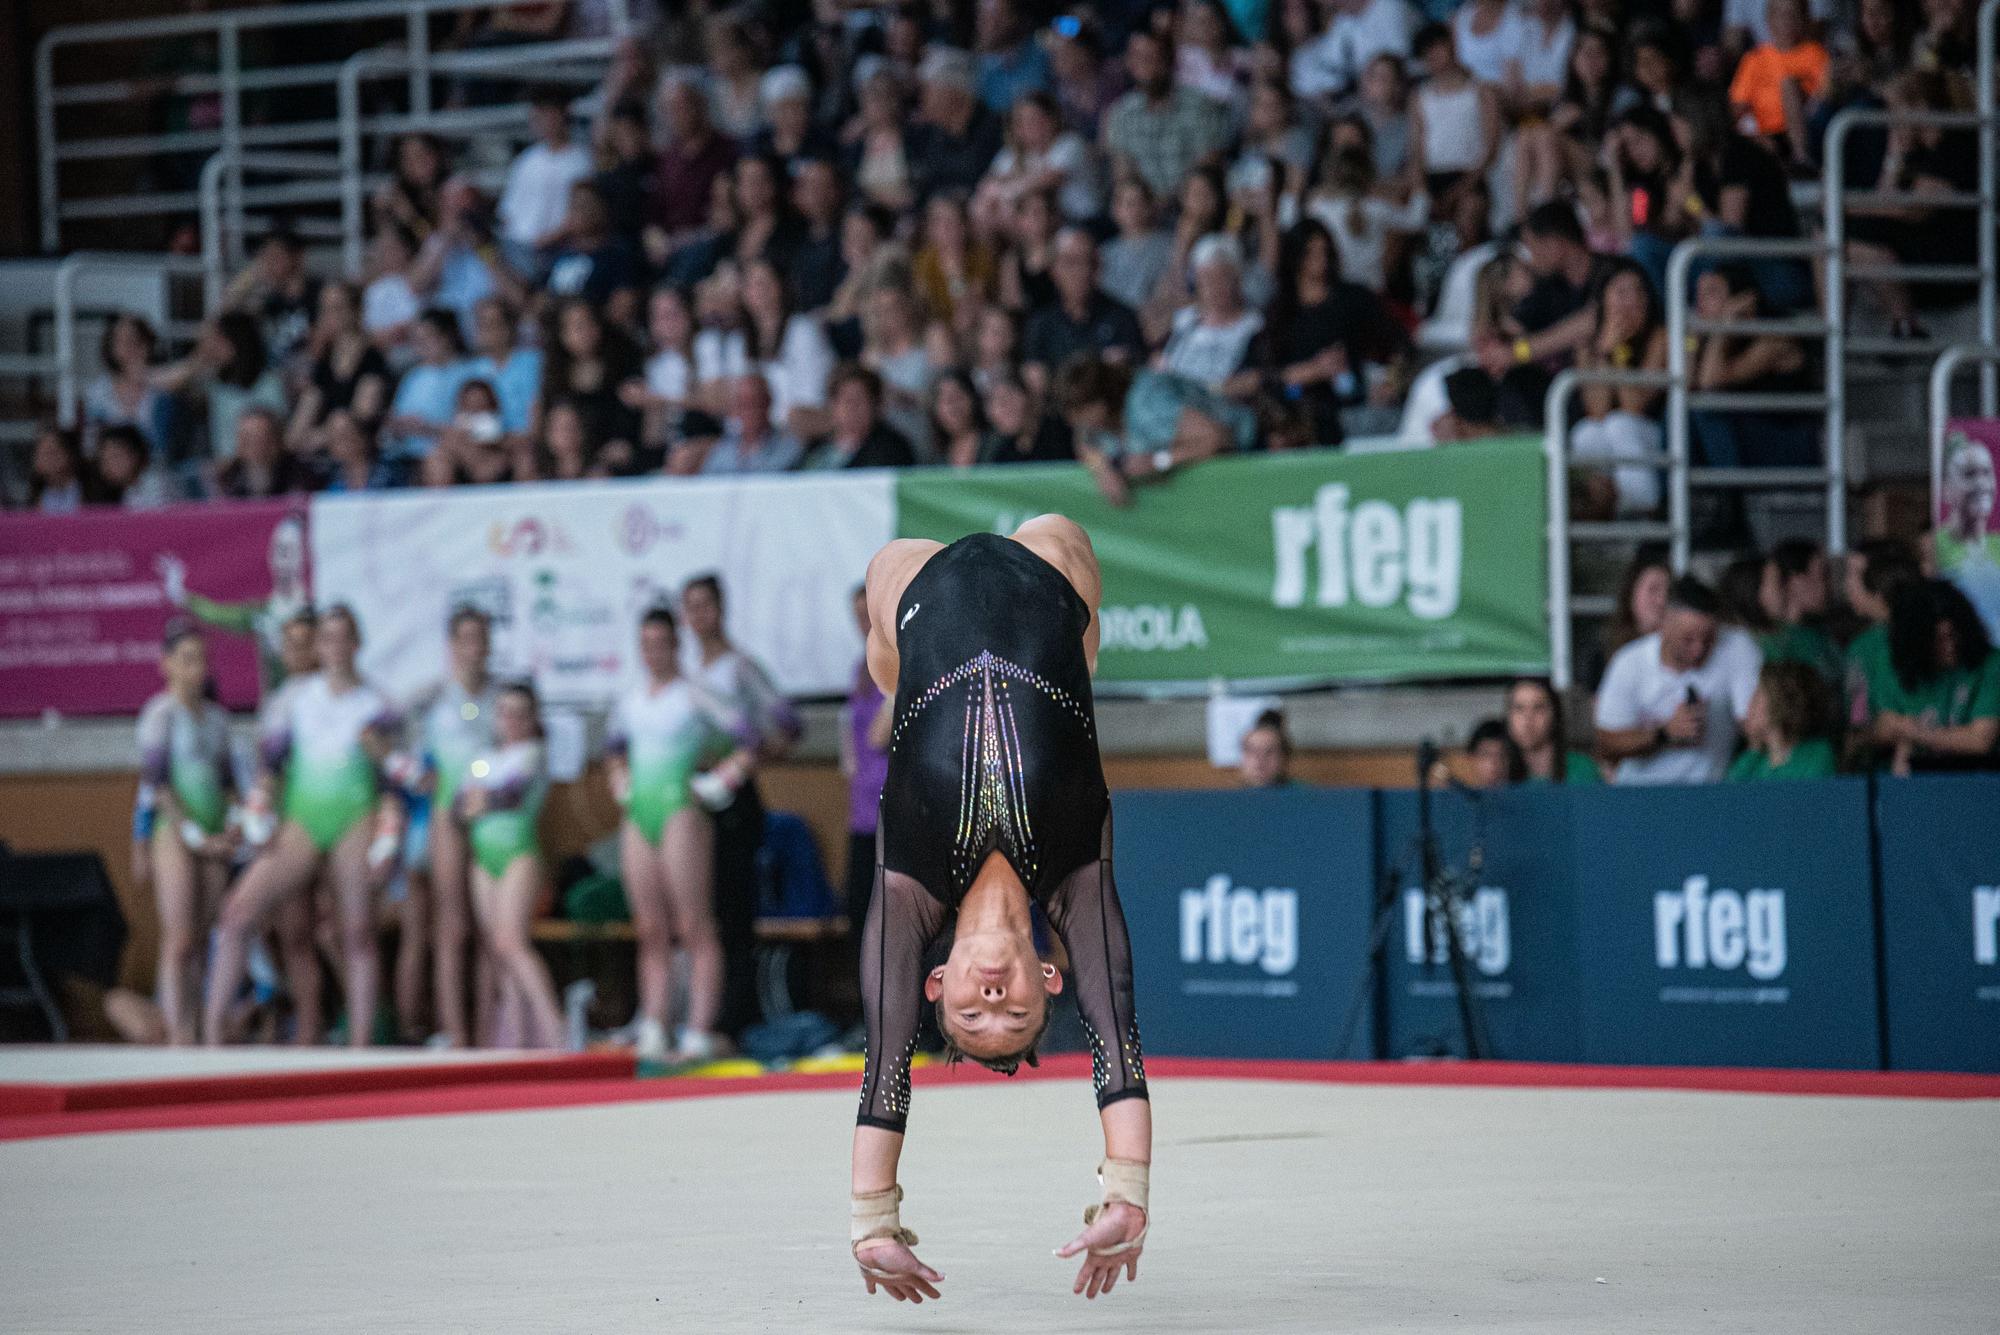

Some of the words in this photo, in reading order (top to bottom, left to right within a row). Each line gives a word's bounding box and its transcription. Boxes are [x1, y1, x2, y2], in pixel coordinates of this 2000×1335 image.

[1273, 482, 1462, 618] rfeg
[1180, 874, 1298, 974] rfeg
[1654, 875, 1787, 980] rfeg
